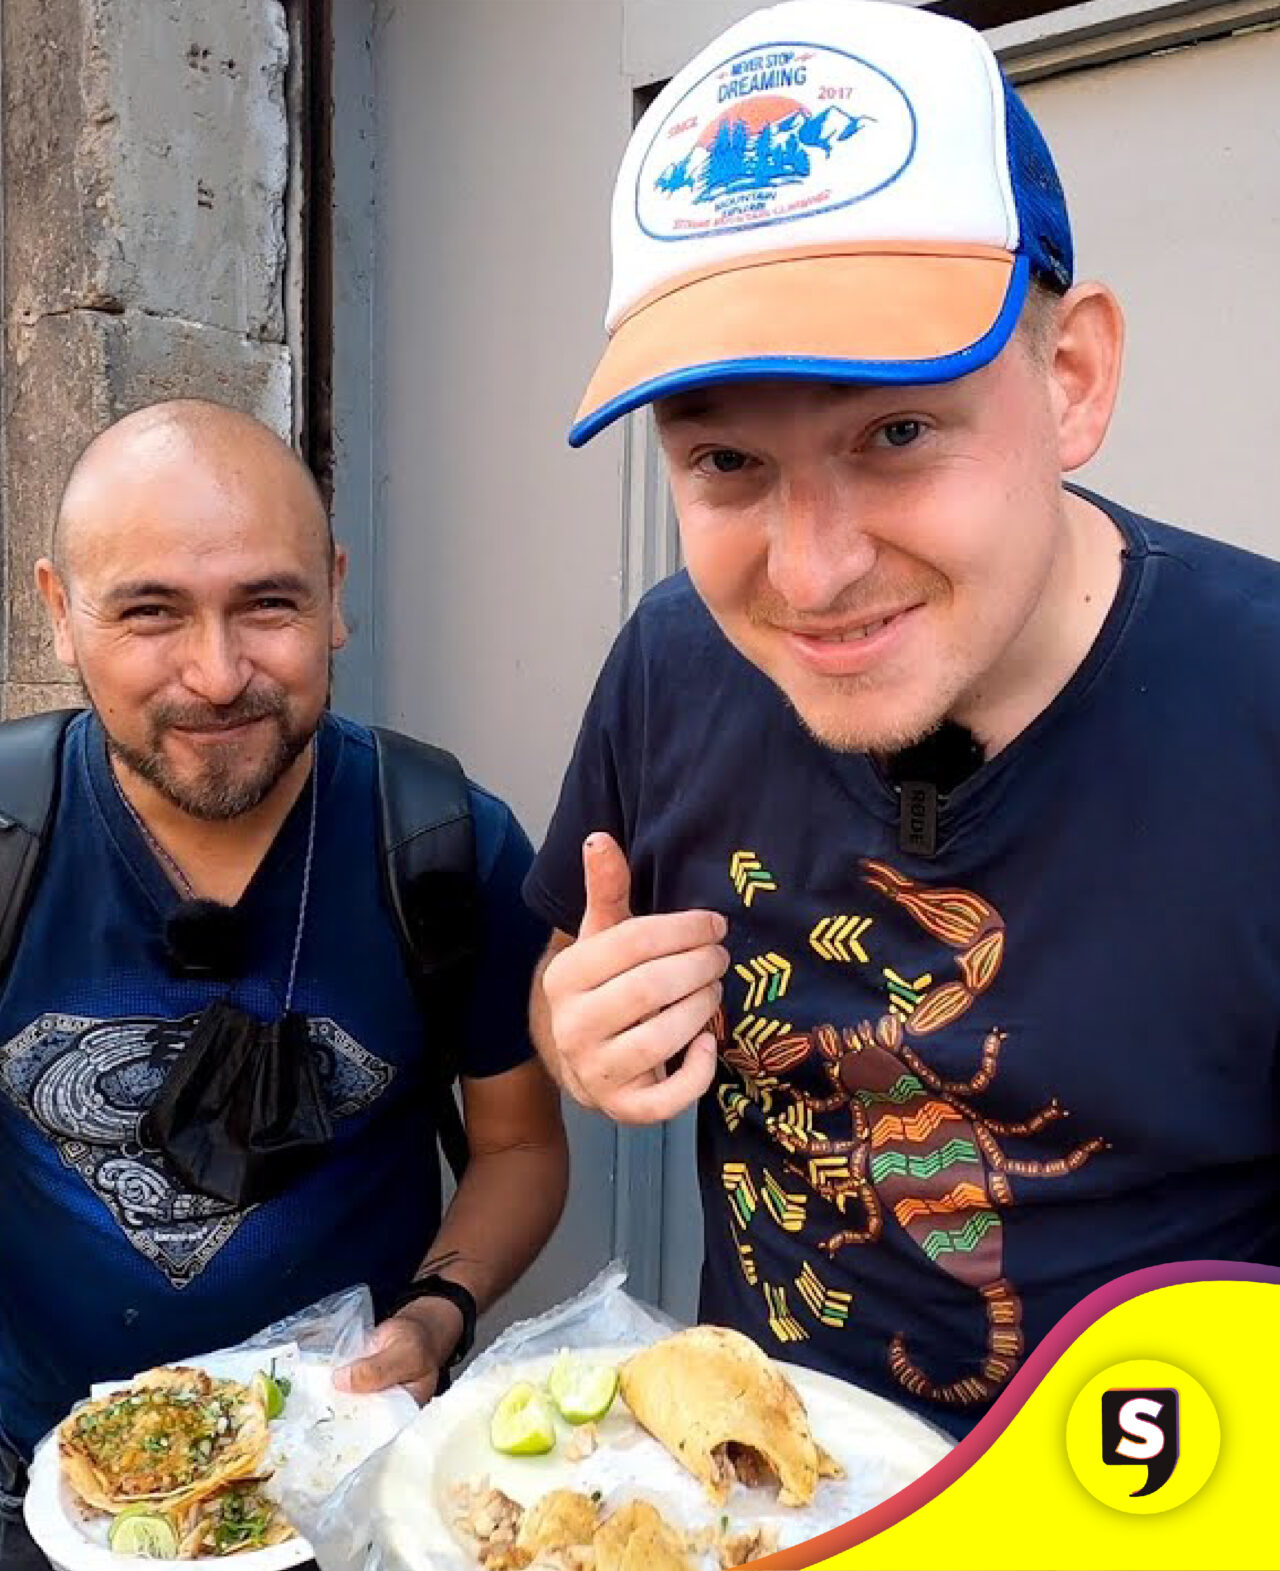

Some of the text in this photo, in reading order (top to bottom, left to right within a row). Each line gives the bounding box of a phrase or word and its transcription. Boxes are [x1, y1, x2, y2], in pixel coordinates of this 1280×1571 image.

[731, 51, 796, 75] NEVER STOP
[718, 66, 807, 103] DREAMING
[817, 87, 854, 100] 2017
